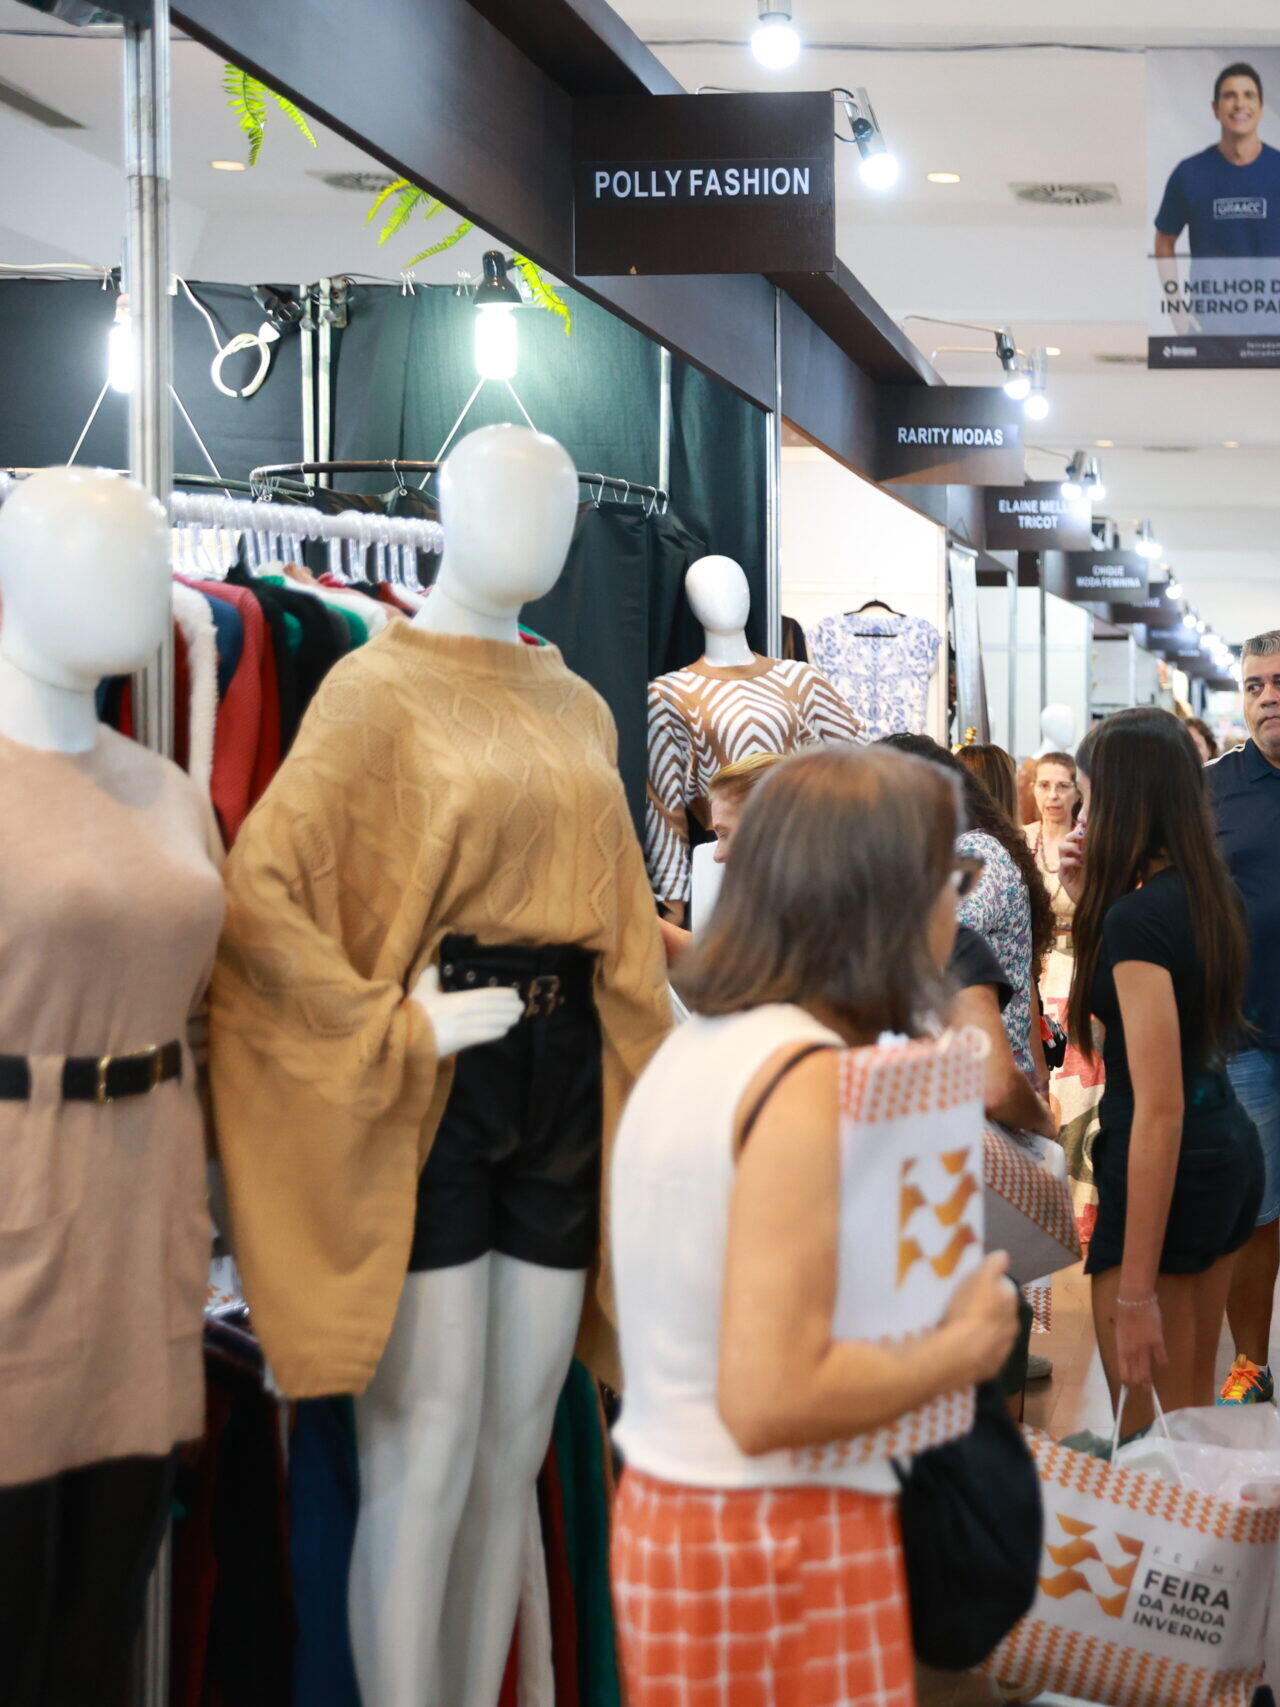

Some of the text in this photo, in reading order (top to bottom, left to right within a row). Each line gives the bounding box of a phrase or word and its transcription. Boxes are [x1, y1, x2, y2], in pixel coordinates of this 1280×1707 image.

[595, 168, 809, 198] POLLY FASHION
[1164, 281, 1178, 294] O
[1184, 280, 1265, 294] MELHOR
[1161, 300, 1248, 314] INVERNO
[898, 427, 1004, 446] RARITY MODAS
[998, 499, 1039, 514] ELAINE
[1018, 515, 1058, 529] TRICOT
[1144, 1569, 1230, 1610] FEIRA
[1138, 1594, 1225, 1628] DA MODA
[1133, 1611, 1222, 1645] INVERNO
